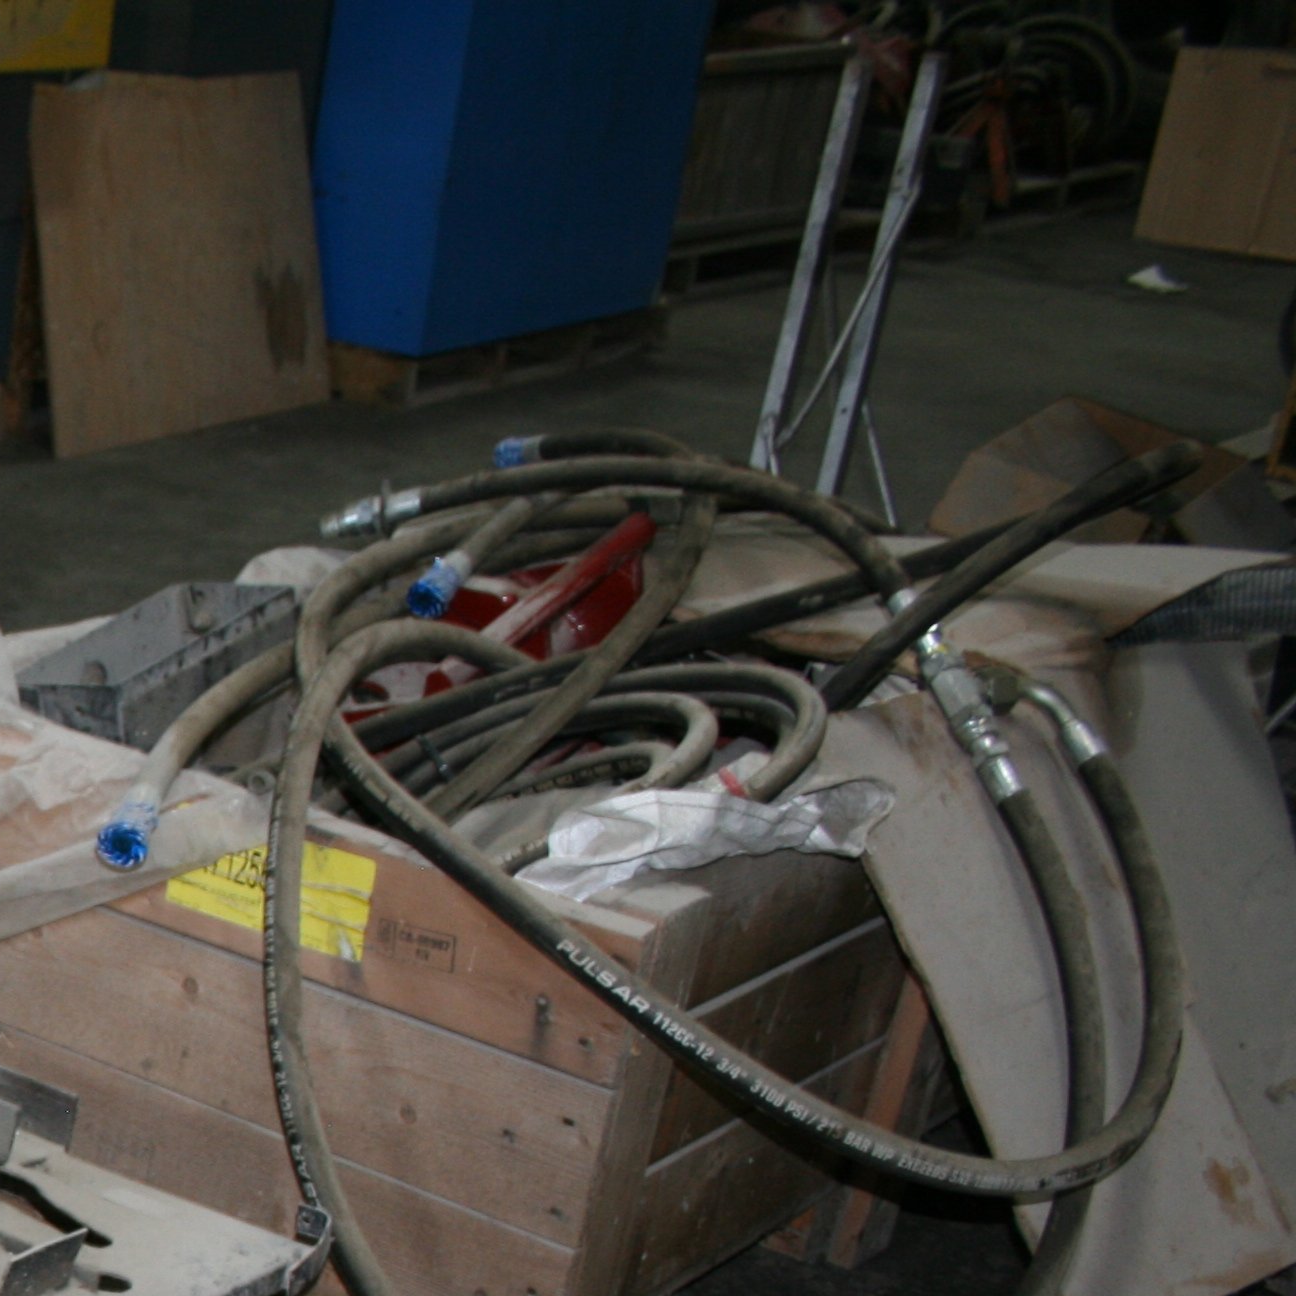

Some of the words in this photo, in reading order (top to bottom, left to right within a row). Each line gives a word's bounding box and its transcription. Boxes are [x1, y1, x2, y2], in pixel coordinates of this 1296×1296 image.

[556, 939, 651, 1014] PULSAR
[652, 1011, 716, 1062] 112CC-12
[749, 1079, 786, 1108] 3100
[843, 1130, 873, 1153] BAR
